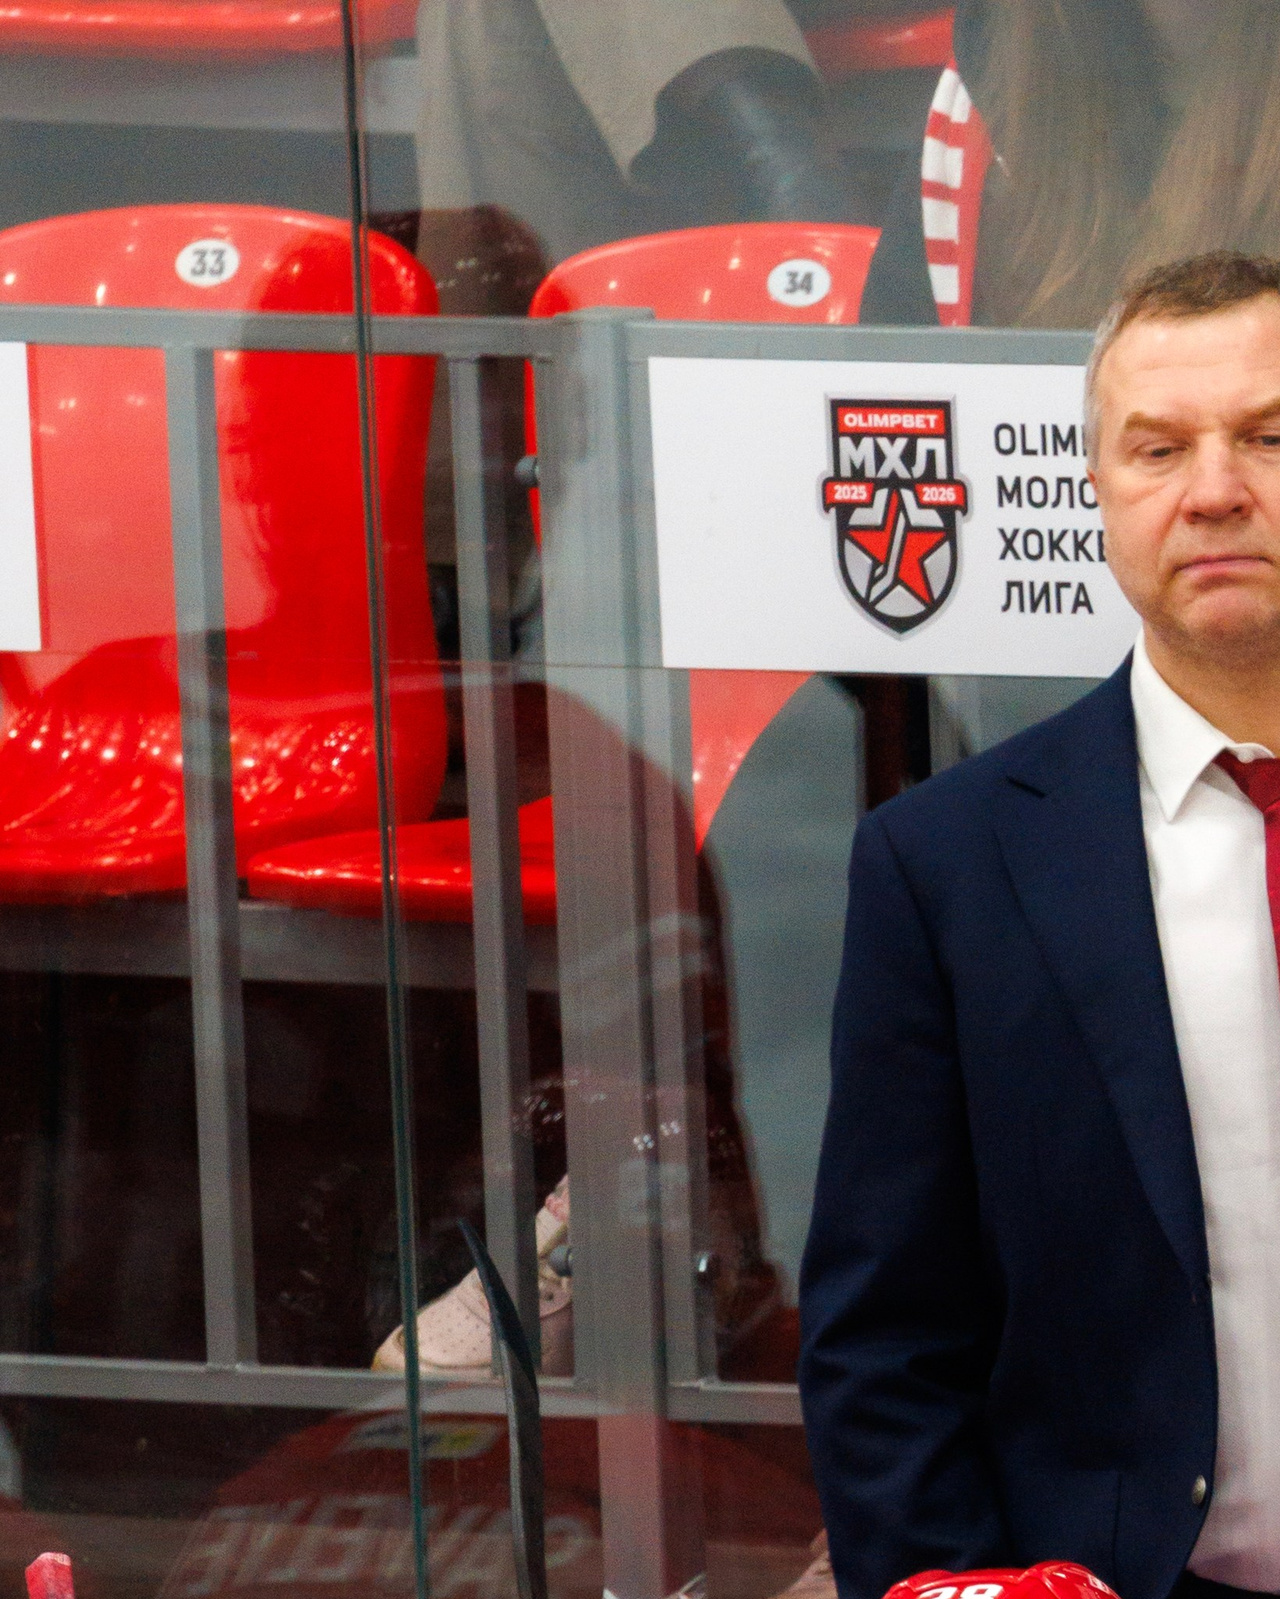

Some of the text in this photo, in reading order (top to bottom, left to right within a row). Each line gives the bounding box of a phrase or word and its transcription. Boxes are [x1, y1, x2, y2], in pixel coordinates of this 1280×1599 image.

[190, 248, 226, 276] 33
[784, 270, 814, 295] 34
[843, 413, 938, 429] OLIMPBET
[839, 436, 948, 478] МХЛ
[833, 485, 957, 502] 2025 2026
[1001, 580, 1095, 615] ЛИГА
